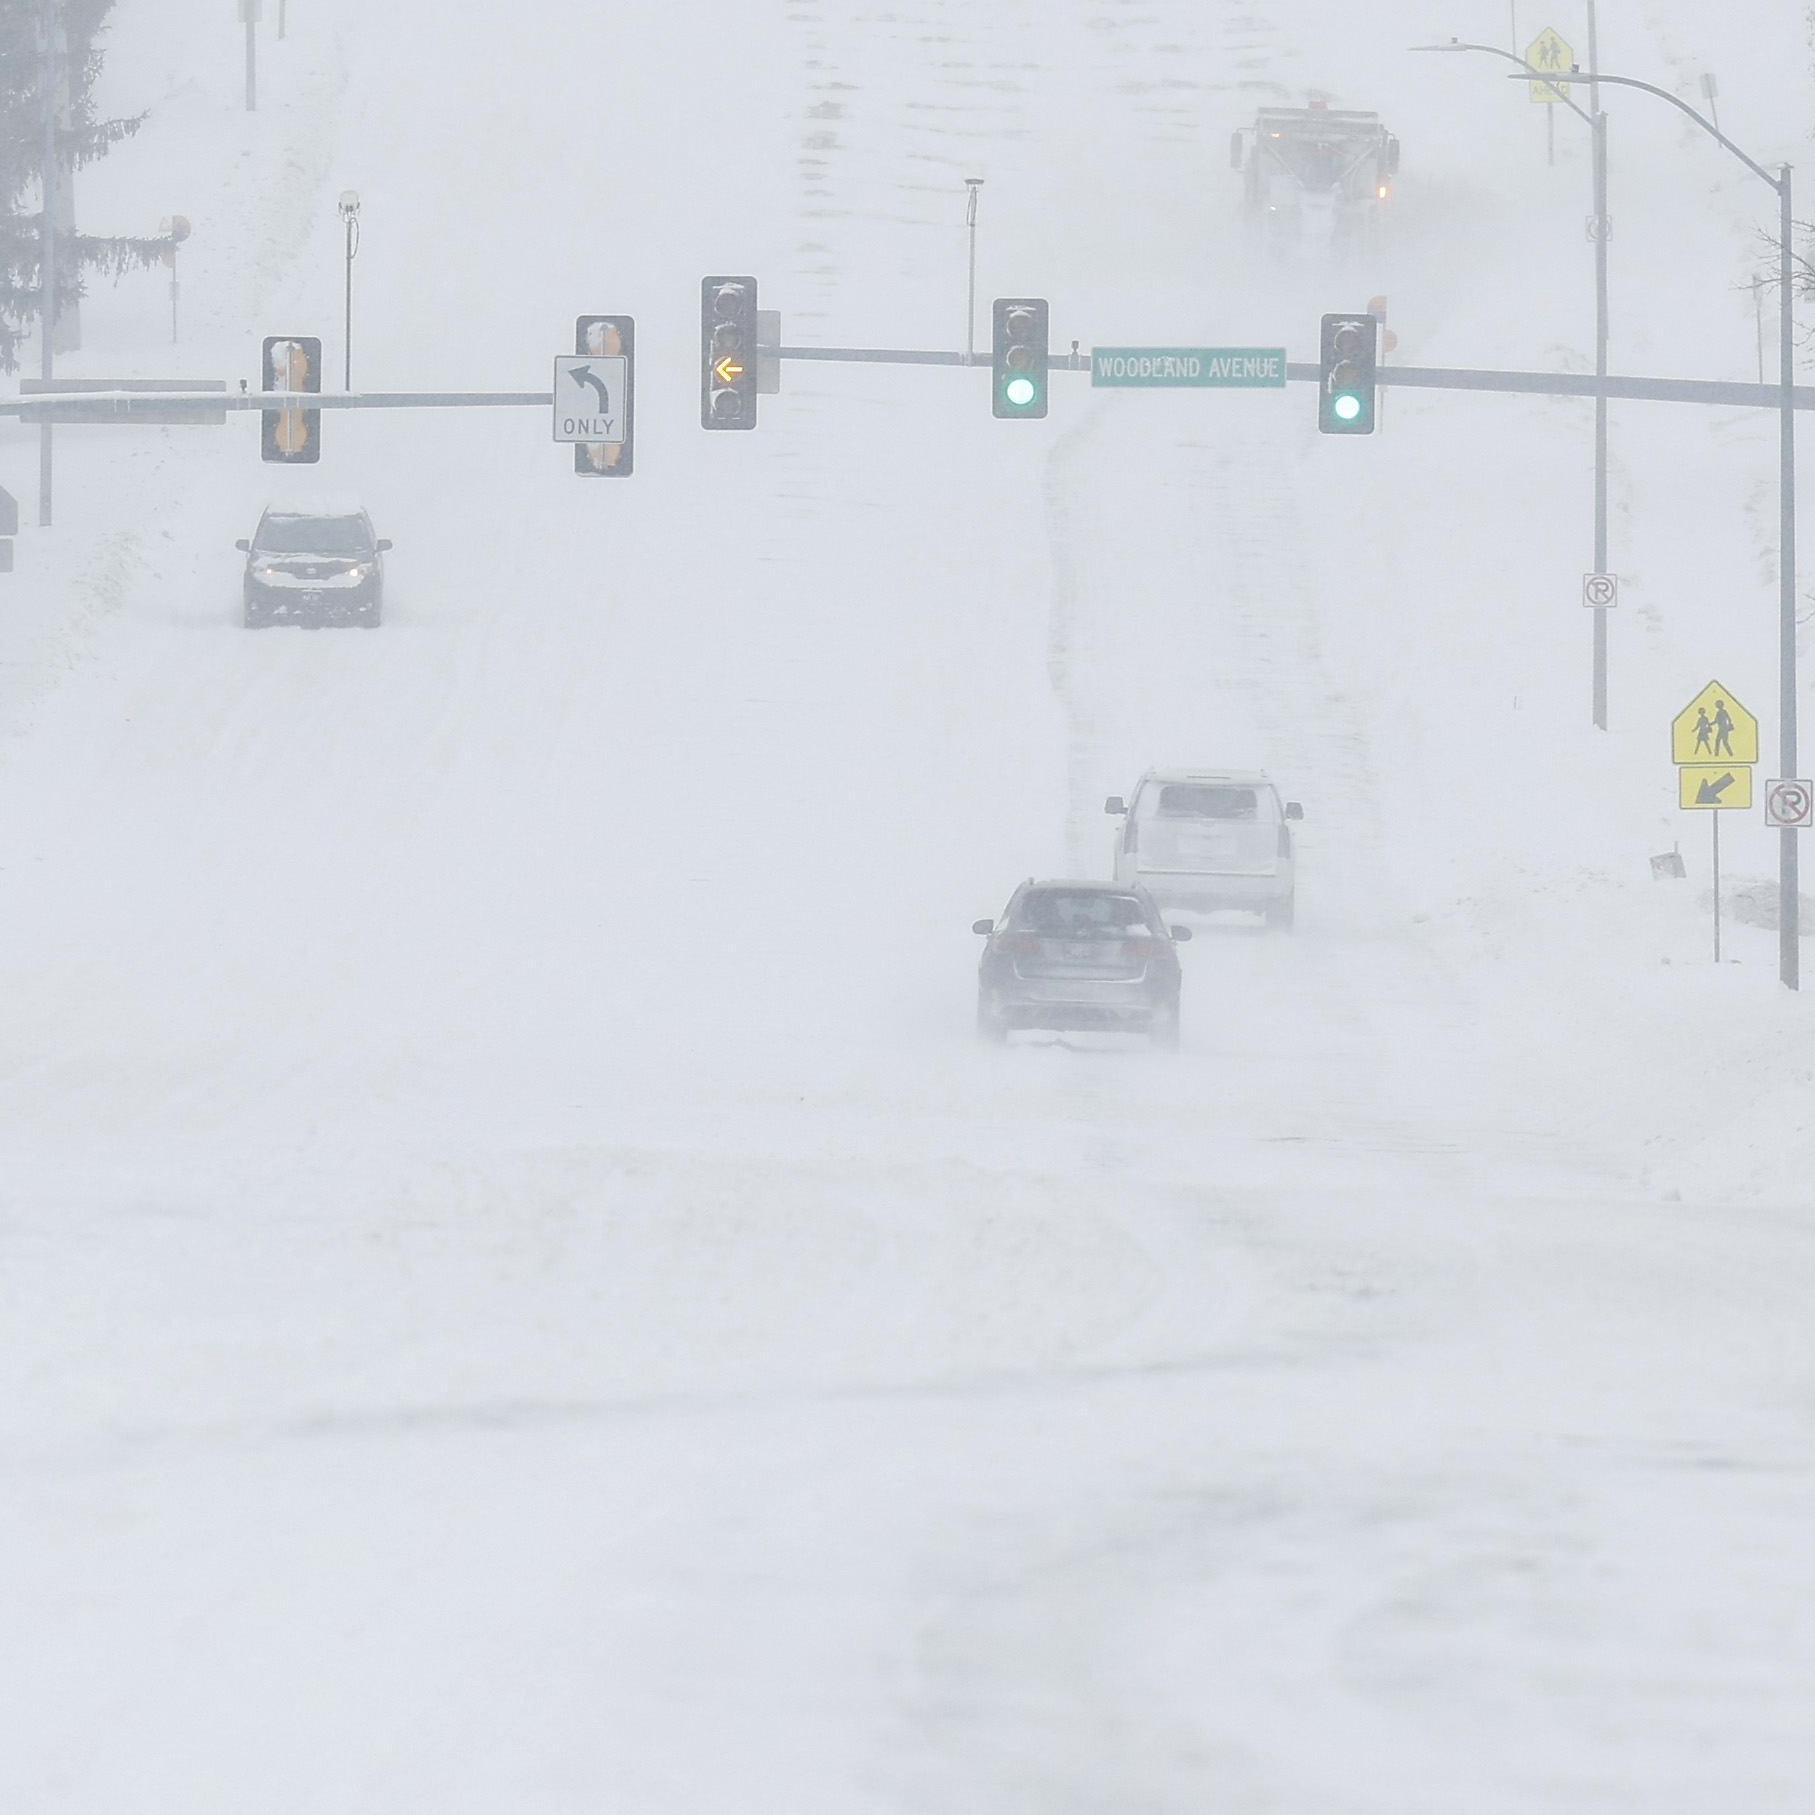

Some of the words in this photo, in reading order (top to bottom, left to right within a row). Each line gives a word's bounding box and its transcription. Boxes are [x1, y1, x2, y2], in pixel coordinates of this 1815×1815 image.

[1098, 356, 1199, 378] WOODLAND
[1209, 357, 1279, 378] AVENUE
[563, 418, 614, 436] ONLY
